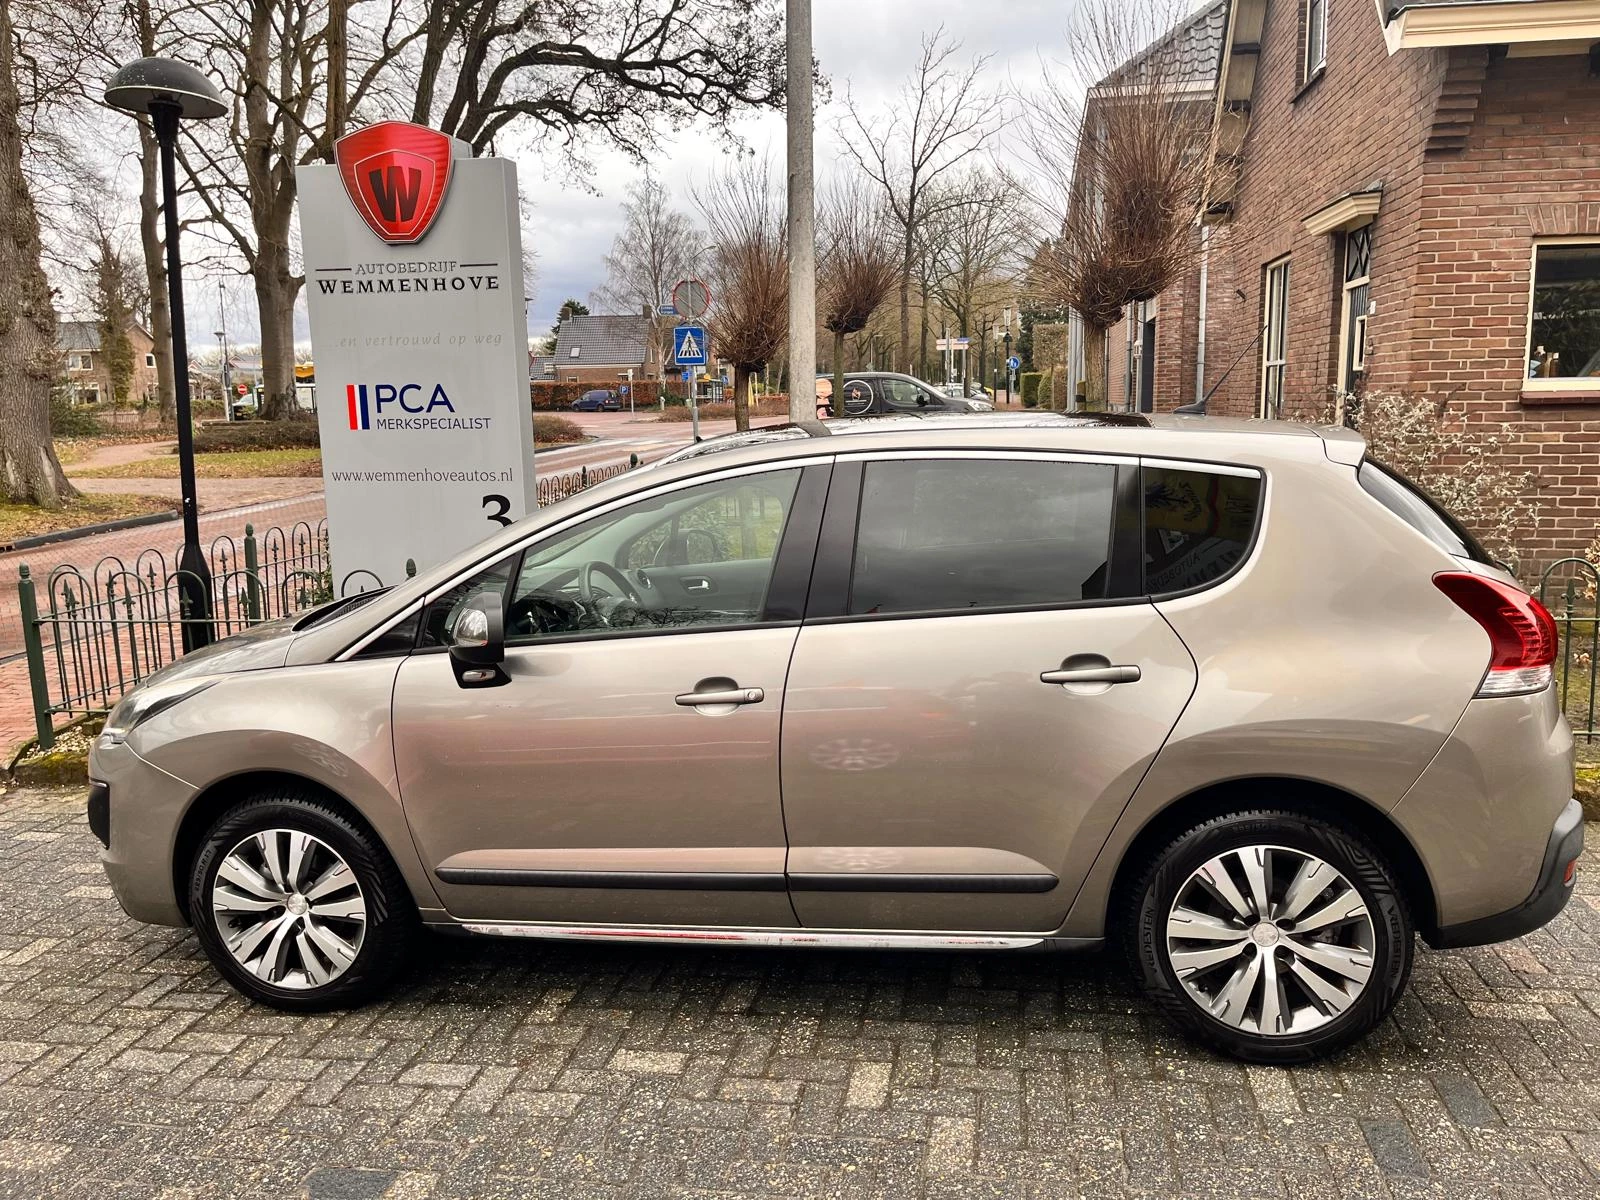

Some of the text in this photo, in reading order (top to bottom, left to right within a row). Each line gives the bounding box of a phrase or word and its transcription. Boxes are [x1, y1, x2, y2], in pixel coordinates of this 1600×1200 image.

[368, 165, 422, 222] W
[355, 261, 457, 275] AUTOBEDRIJF
[316, 275, 499, 295] WEMMENHOVE
[365, 333, 441, 347] vertrouwd
[449, 334, 466, 346] op
[474, 333, 502, 345] weg
[375, 383, 456, 413] PCA
[376, 417, 492, 430] MERKSPECIALIST
[331, 468, 513, 482] www.wemmenhoveautos.nl
